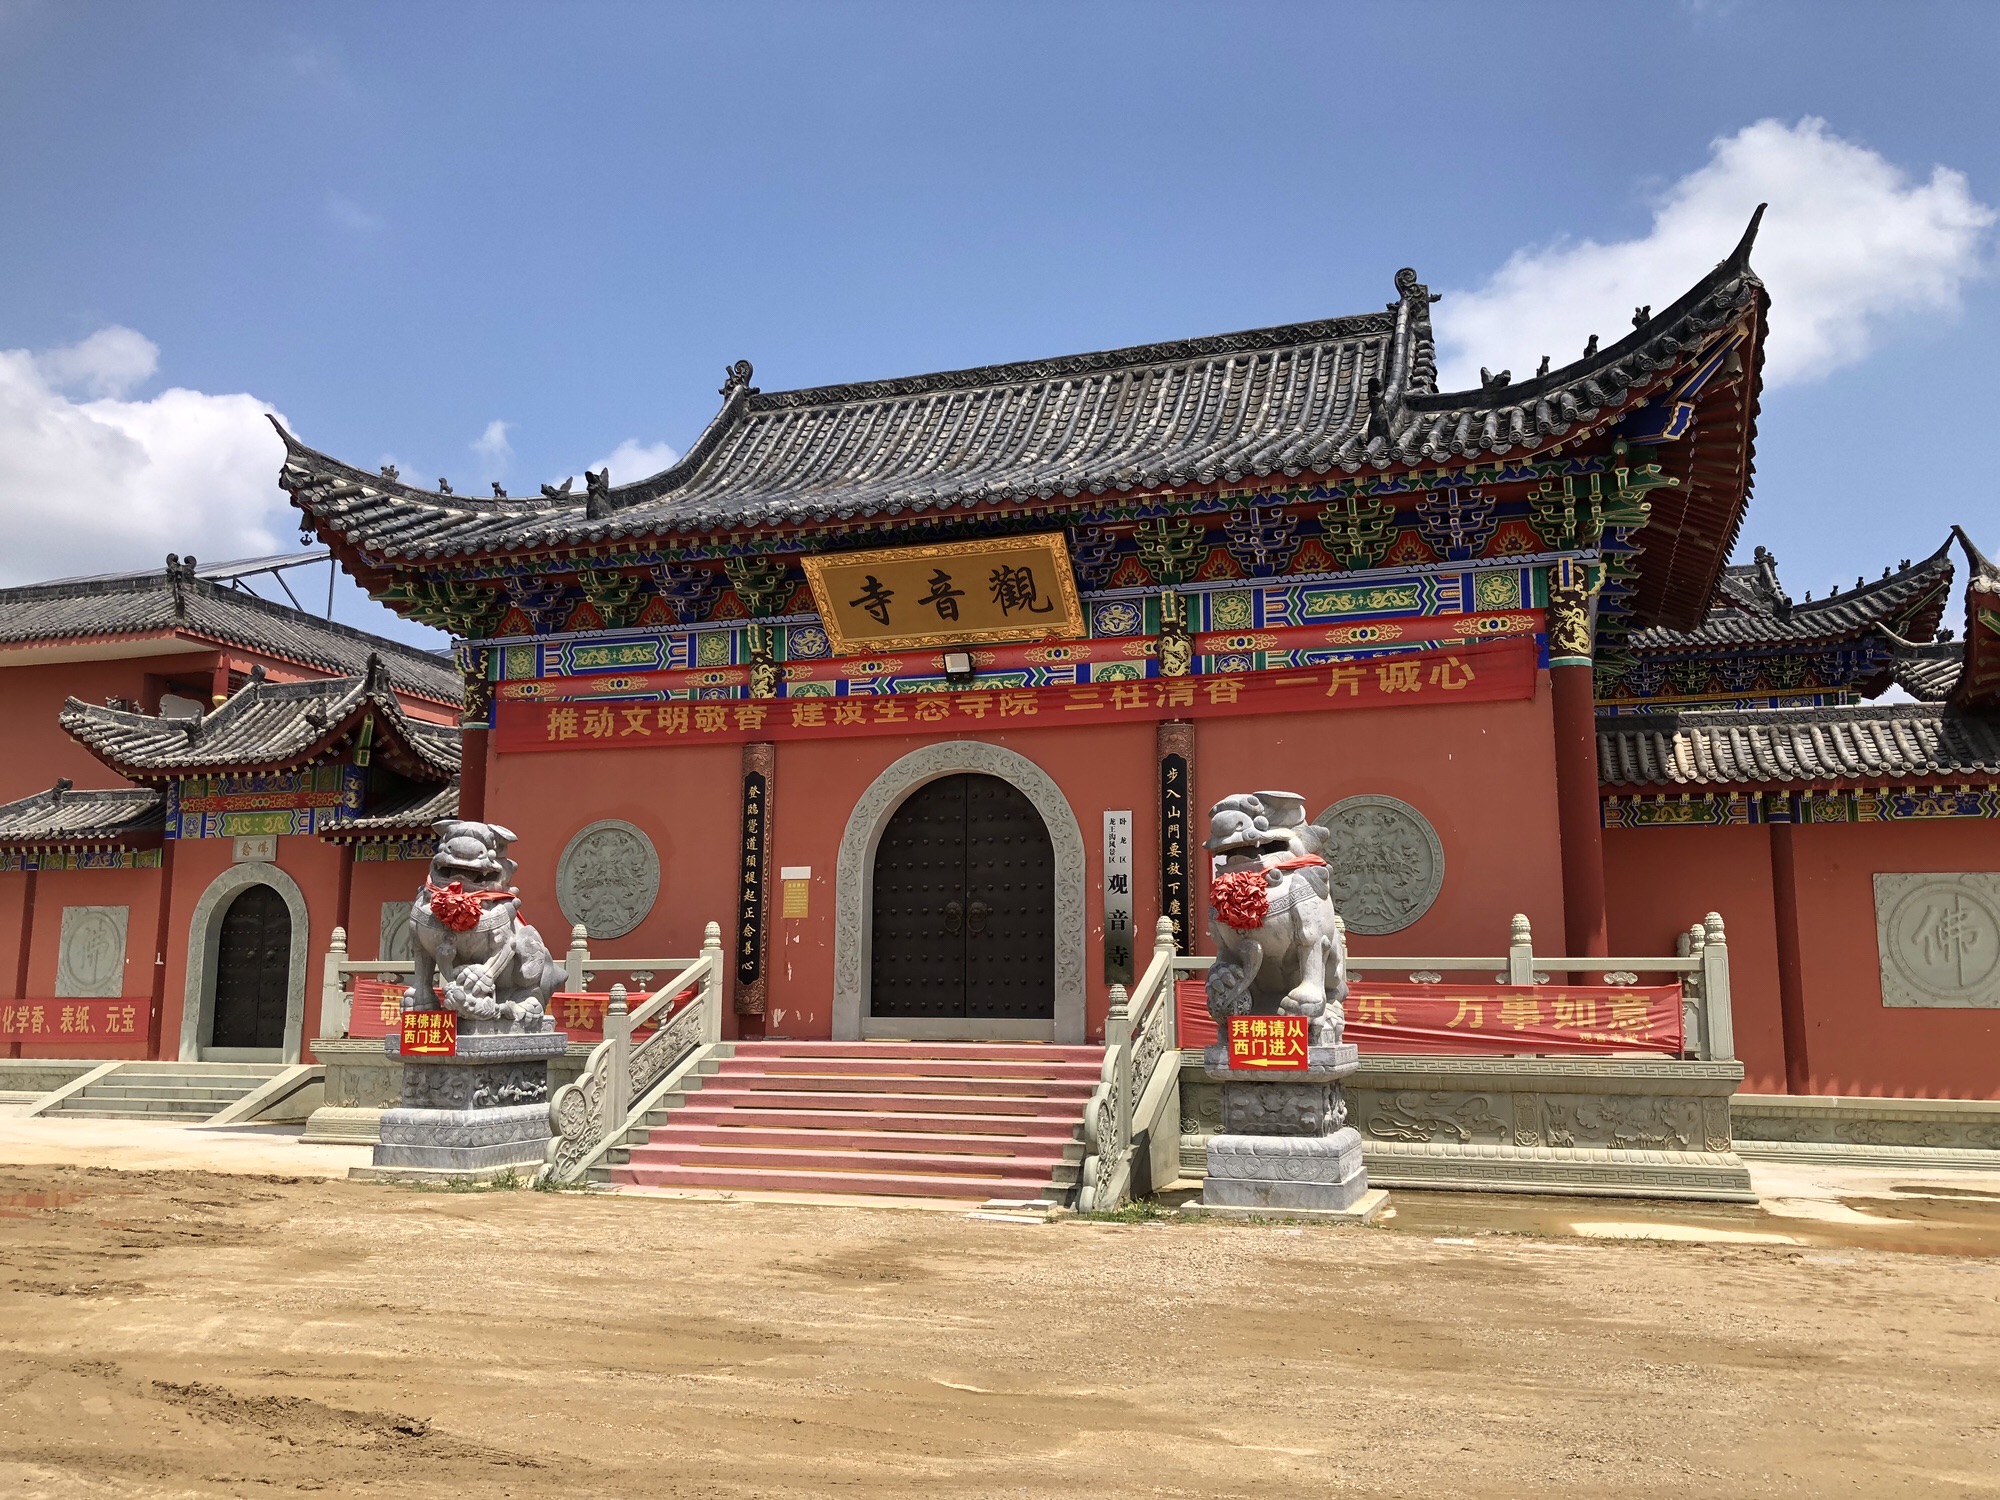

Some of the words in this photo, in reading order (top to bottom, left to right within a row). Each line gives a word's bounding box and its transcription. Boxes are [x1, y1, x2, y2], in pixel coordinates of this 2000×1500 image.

[850, 564, 1054, 626] 觀音寺
[546, 704, 768, 741] 推动文明敬香
[791, 691, 1039, 728] 建设生态寺院
[1275, 656, 1476, 697] 一片诚心
[1107, 873, 1129, 968] 观音寺
[0, 1004, 136, 1034] 化学香、表纸、元宝
[404, 1013, 454, 1029] 拜佛请从
[1444, 993, 1655, 1031] 万事如意
[403, 1029, 455, 1044] 西门进入
[1231, 1019, 1305, 1037] 拜佛请从
[1232, 1038, 1305, 1056] 西门进入
